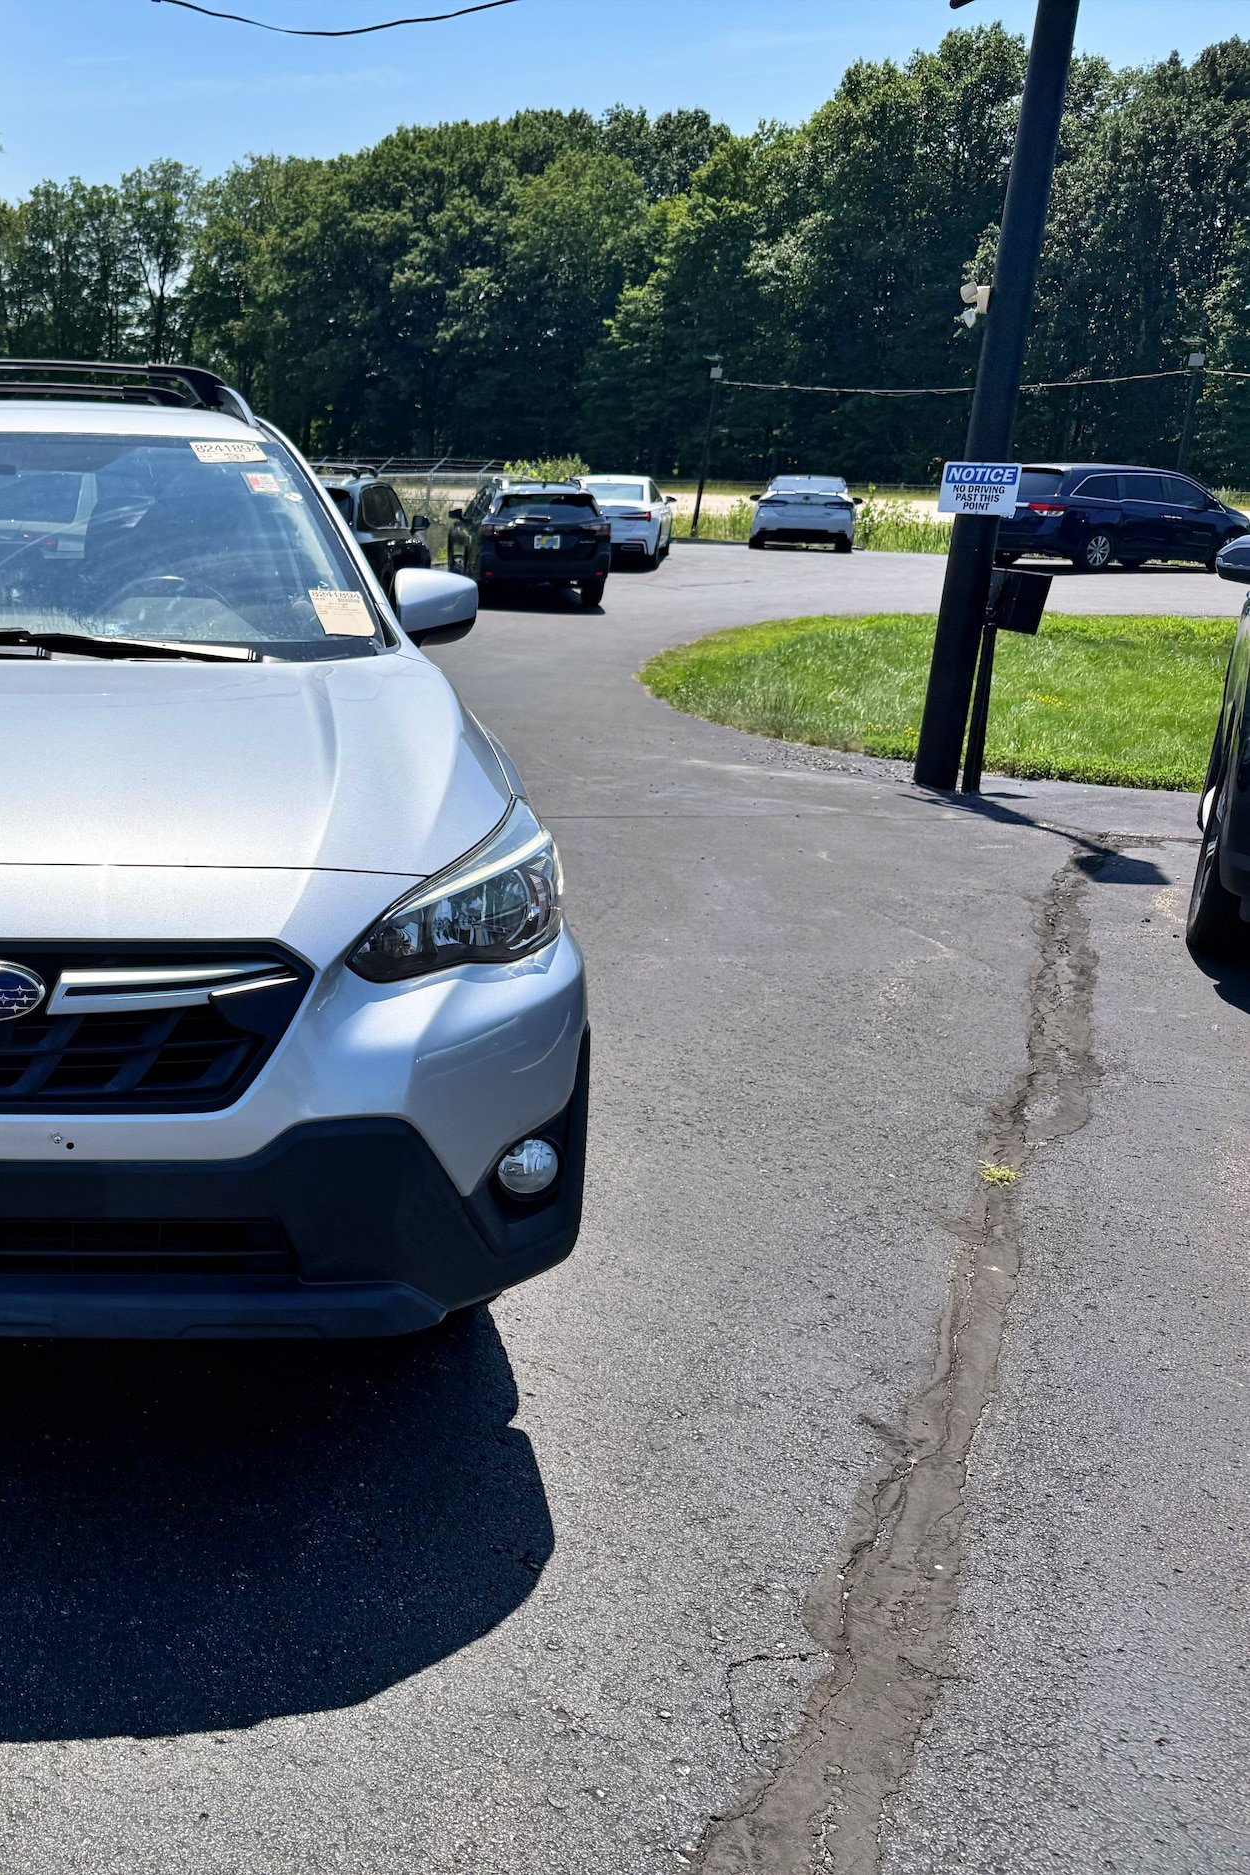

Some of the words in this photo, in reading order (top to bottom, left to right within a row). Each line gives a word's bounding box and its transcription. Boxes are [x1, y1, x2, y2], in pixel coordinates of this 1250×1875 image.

[194, 444, 260, 453] 8241894
[948, 467, 1016, 482] NOTICE
[952, 484, 966, 493] NO
[967, 485, 1005, 494] DRIVING
[955, 493, 978, 502] PAST
[979, 494, 1000, 503] THIS
[962, 502, 990, 511] POINT
